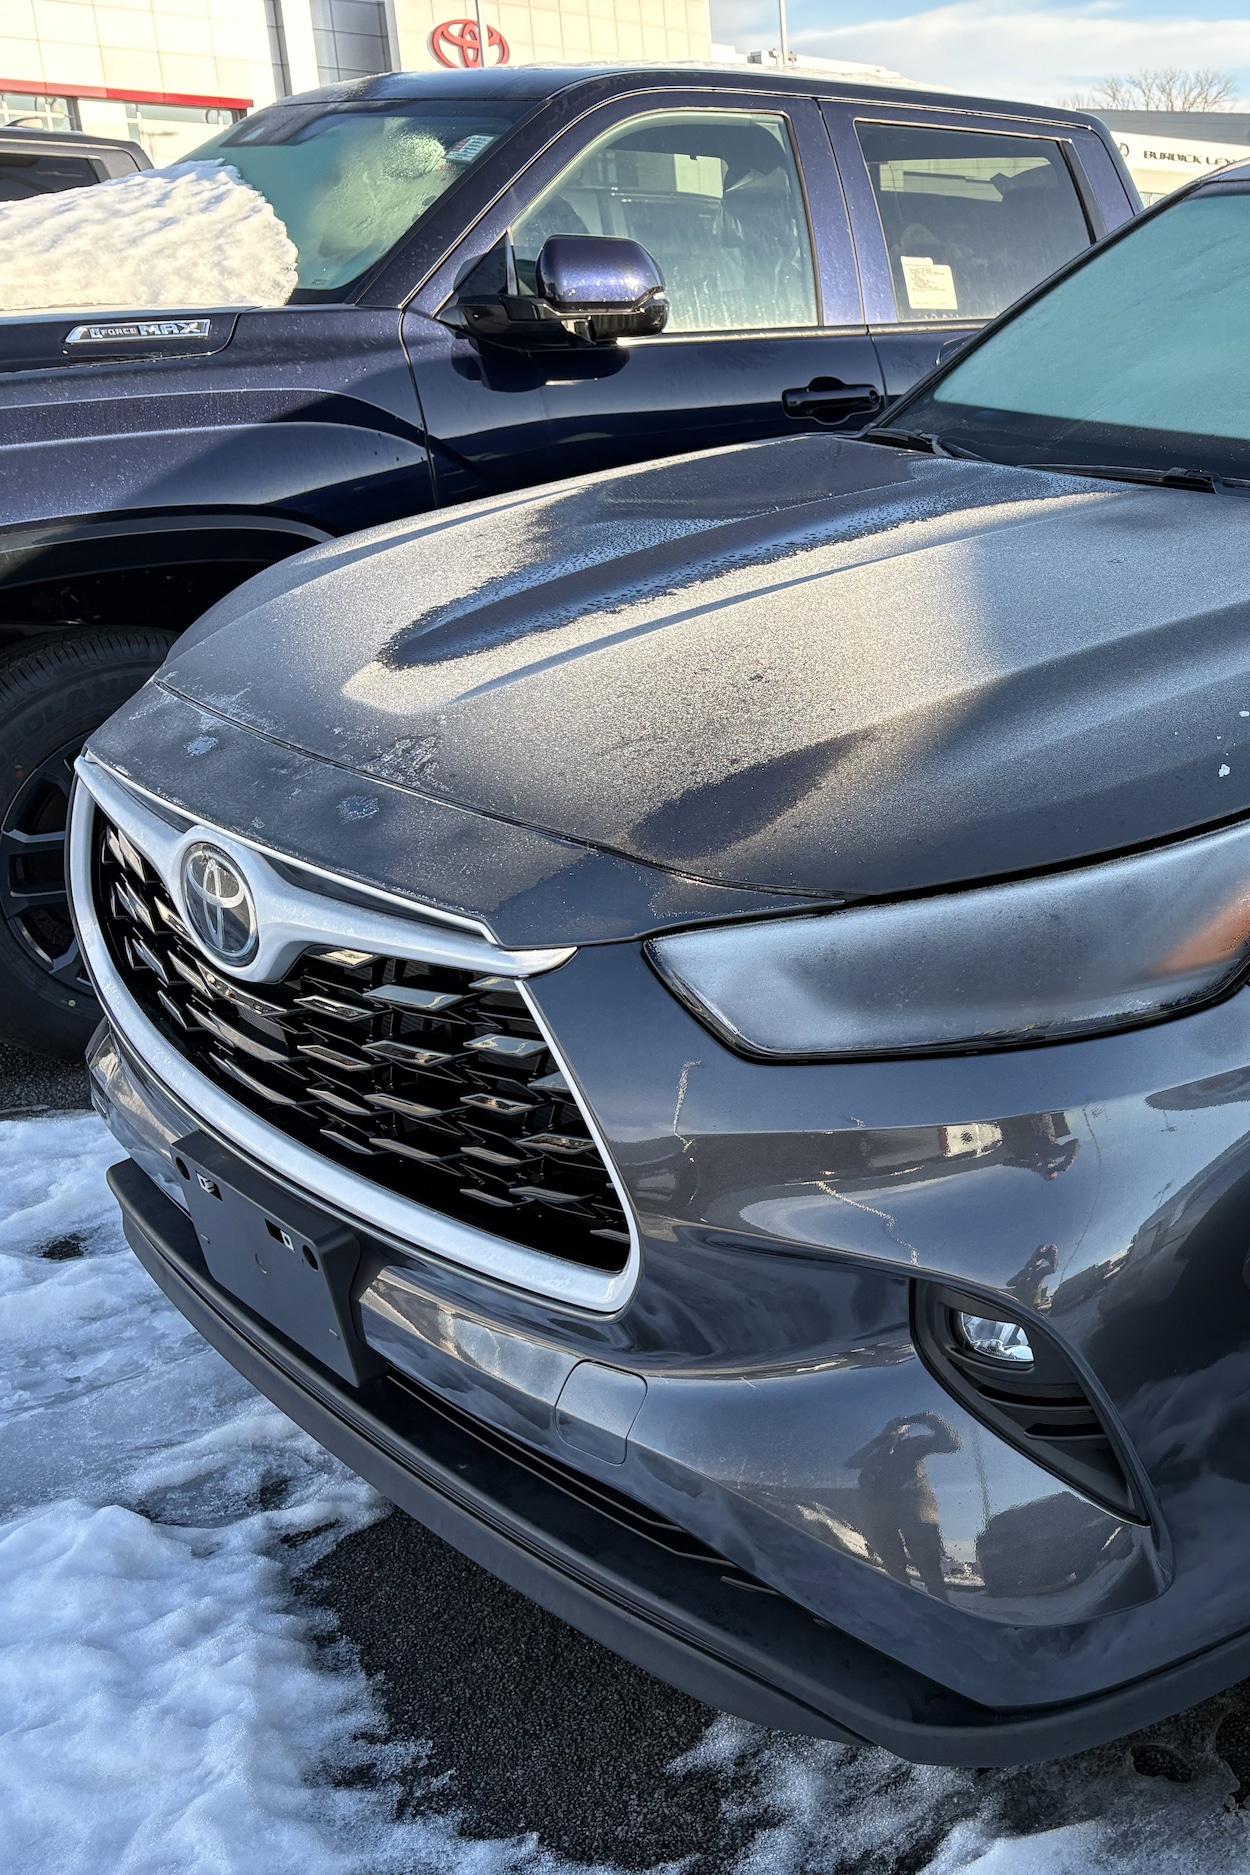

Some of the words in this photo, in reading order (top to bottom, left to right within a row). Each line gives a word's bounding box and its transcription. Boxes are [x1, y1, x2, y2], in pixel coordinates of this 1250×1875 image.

[1143, 150, 1202, 164] BURDICK
[1206, 156, 1236, 167] LEX
[138, 322, 200, 336] MAX
